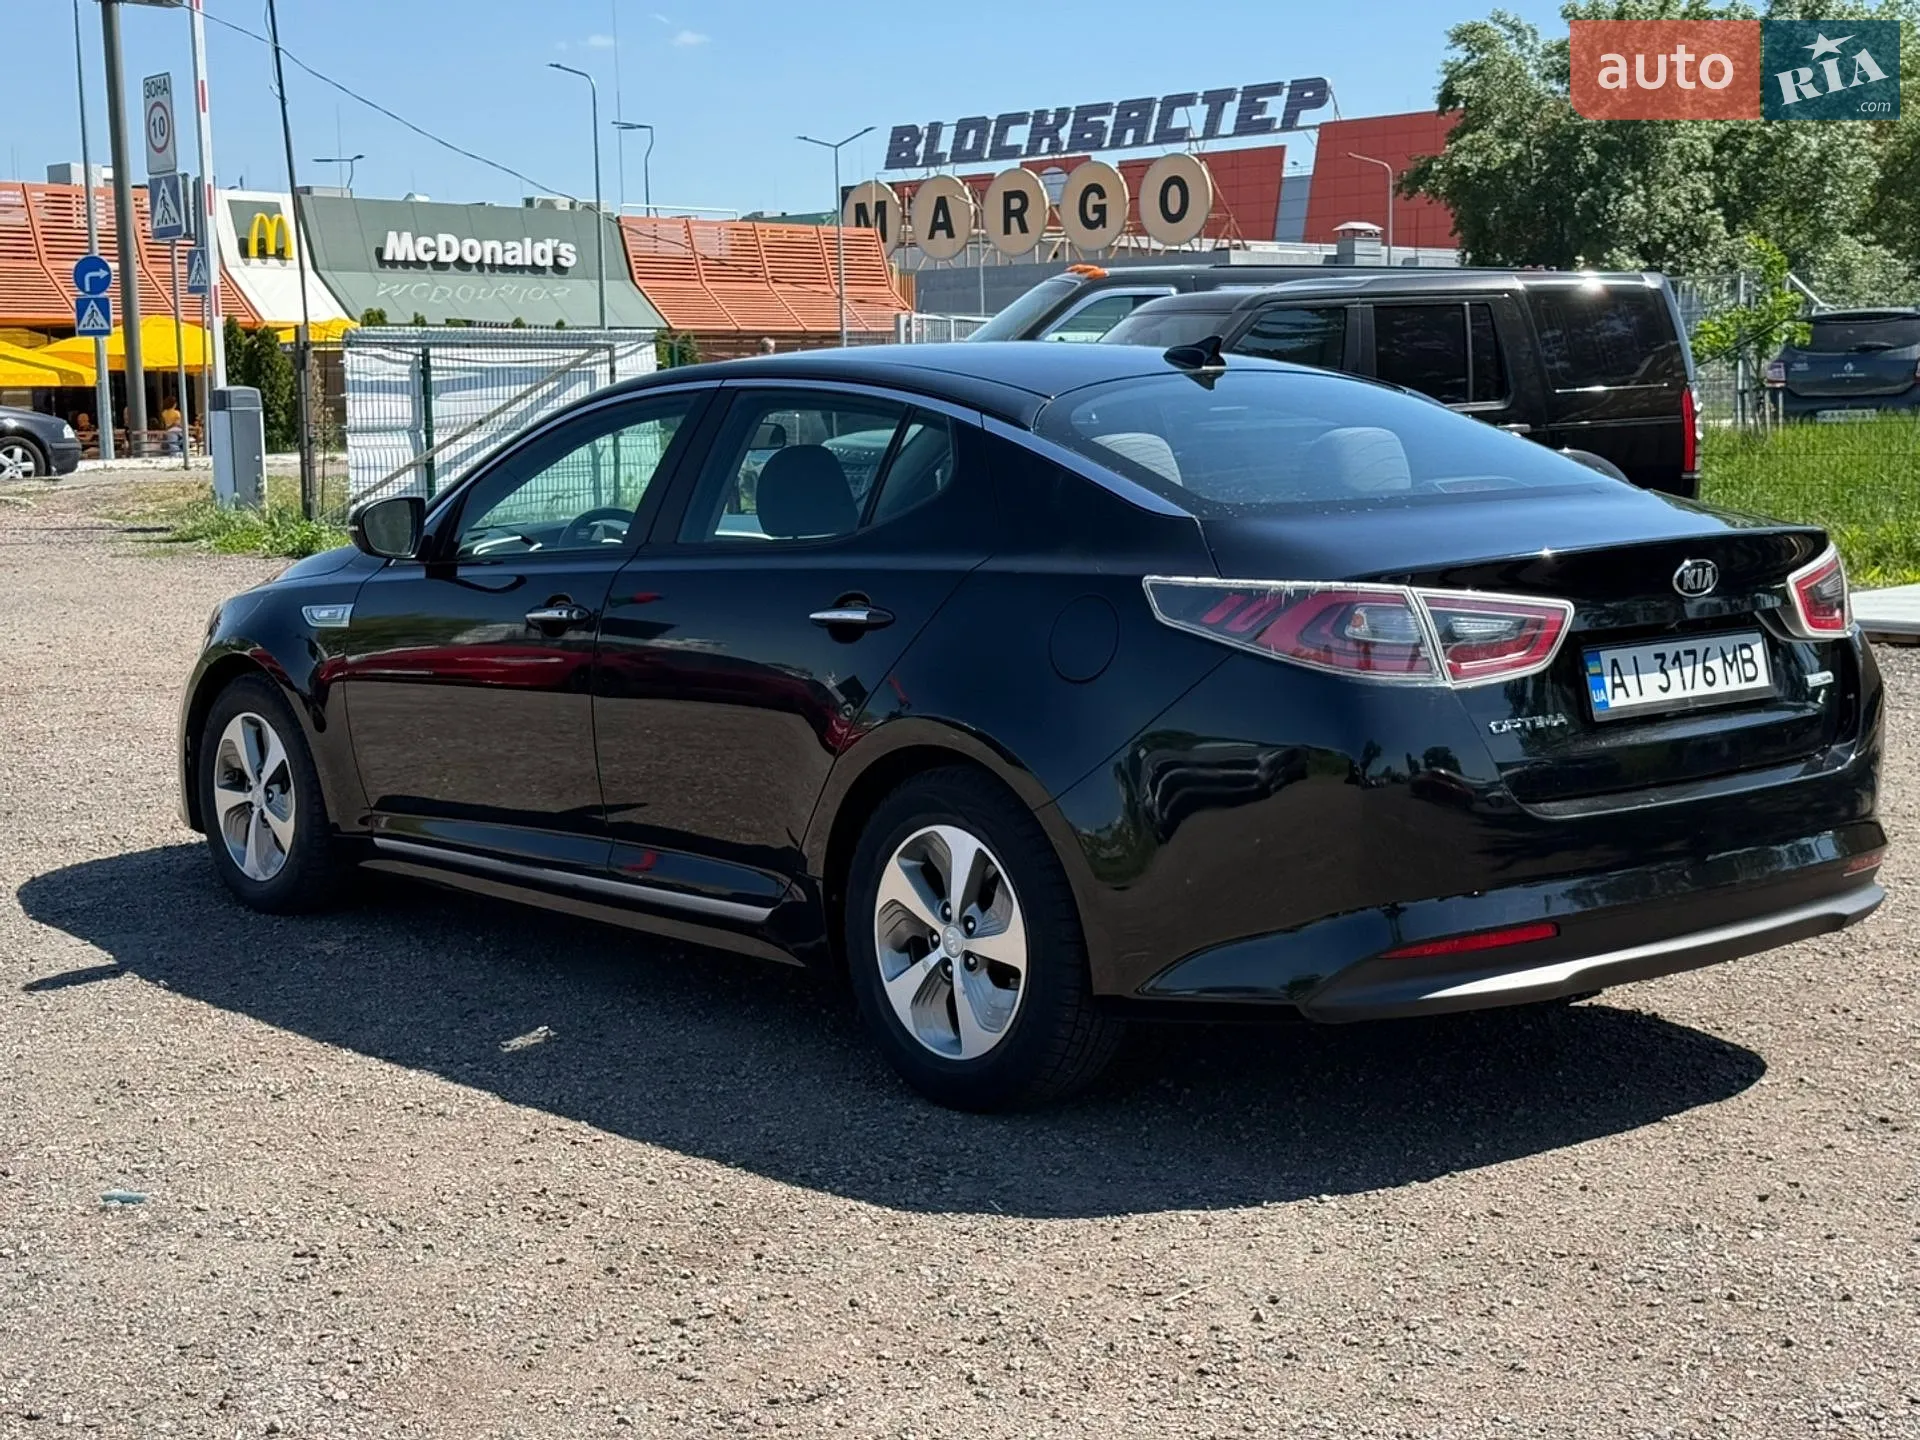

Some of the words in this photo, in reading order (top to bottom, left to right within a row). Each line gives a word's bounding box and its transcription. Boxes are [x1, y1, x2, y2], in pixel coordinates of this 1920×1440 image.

[144, 78, 169, 99] ЗОНА
[152, 116, 166, 139] 10
[383, 230, 577, 269] McDonald's
[1682, 567, 1714, 590] KIA
[1611, 655, 1644, 700] AI
[1654, 646, 1717, 693] 3176
[1719, 642, 1759, 686] MB
[1592, 690, 1608, 702] UA
